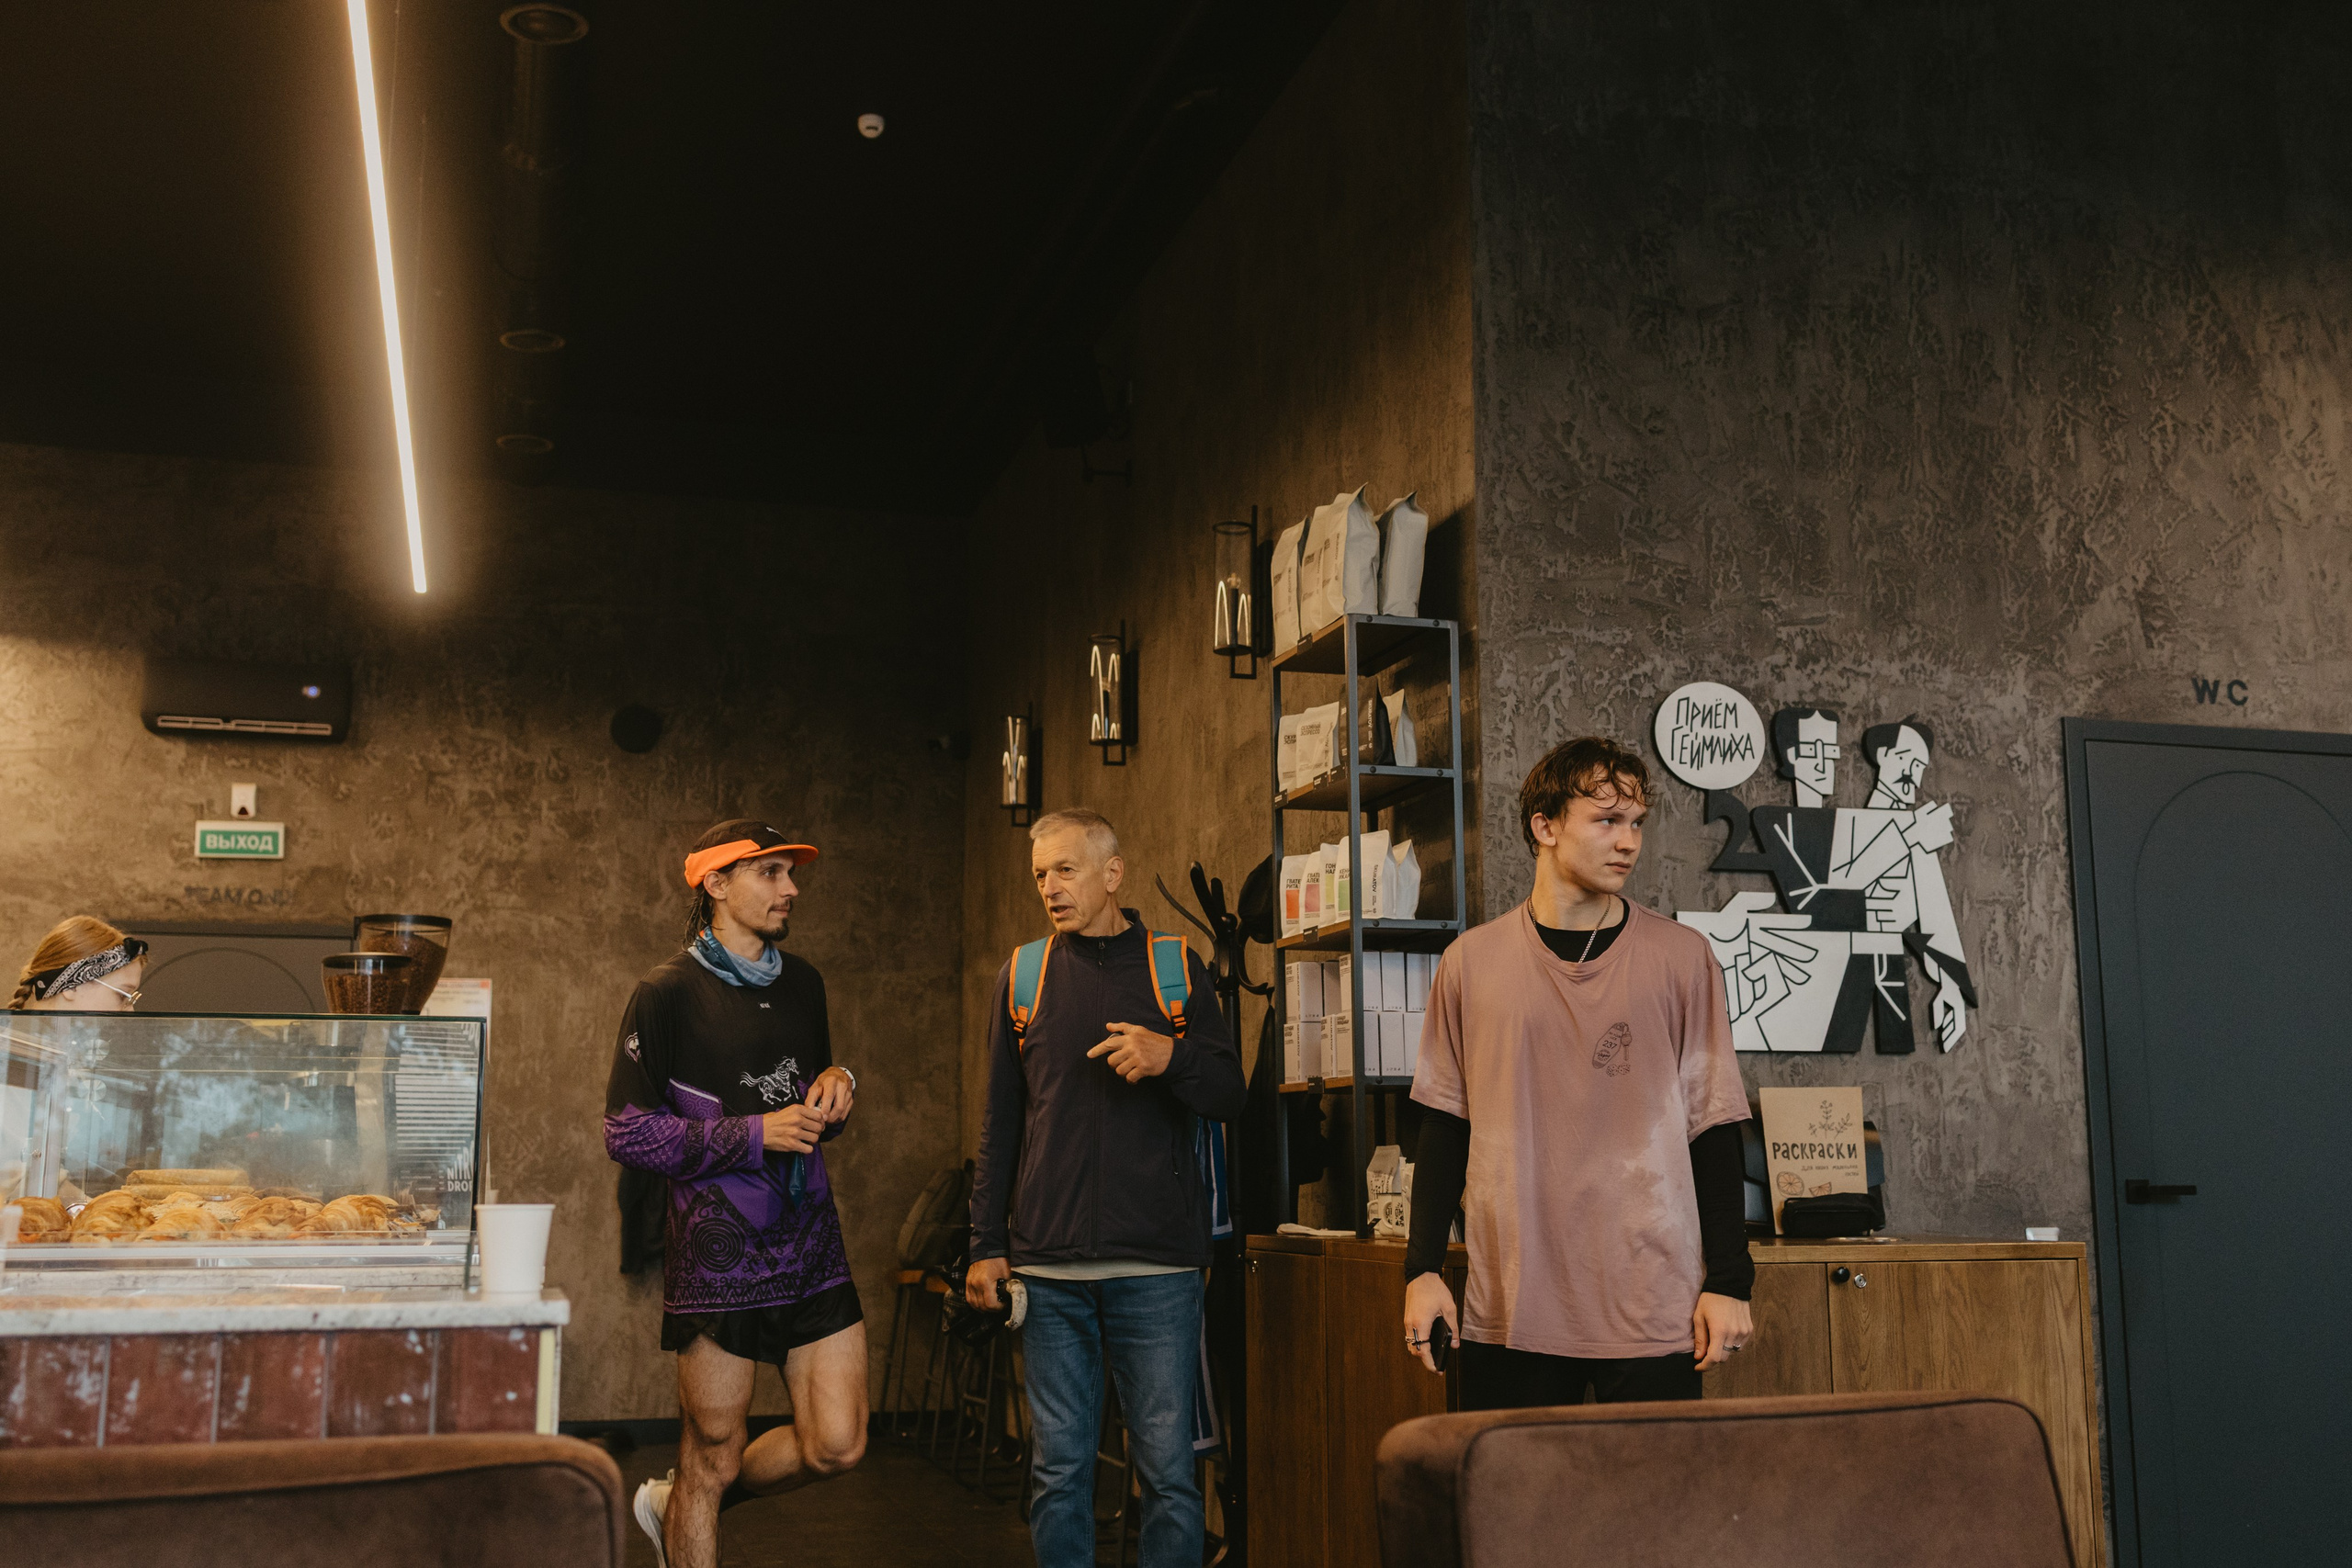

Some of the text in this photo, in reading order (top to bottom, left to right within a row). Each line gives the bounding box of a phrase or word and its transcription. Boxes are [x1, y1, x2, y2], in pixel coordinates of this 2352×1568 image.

[2190, 677, 2248, 705] WC
[1676, 696, 1738, 733] ПРИЁМ
[1670, 725, 1755, 771] ГЕЙМЛИХА
[205, 833, 274, 852] ВЫХОД
[1602, 1040, 1617, 1050] 237
